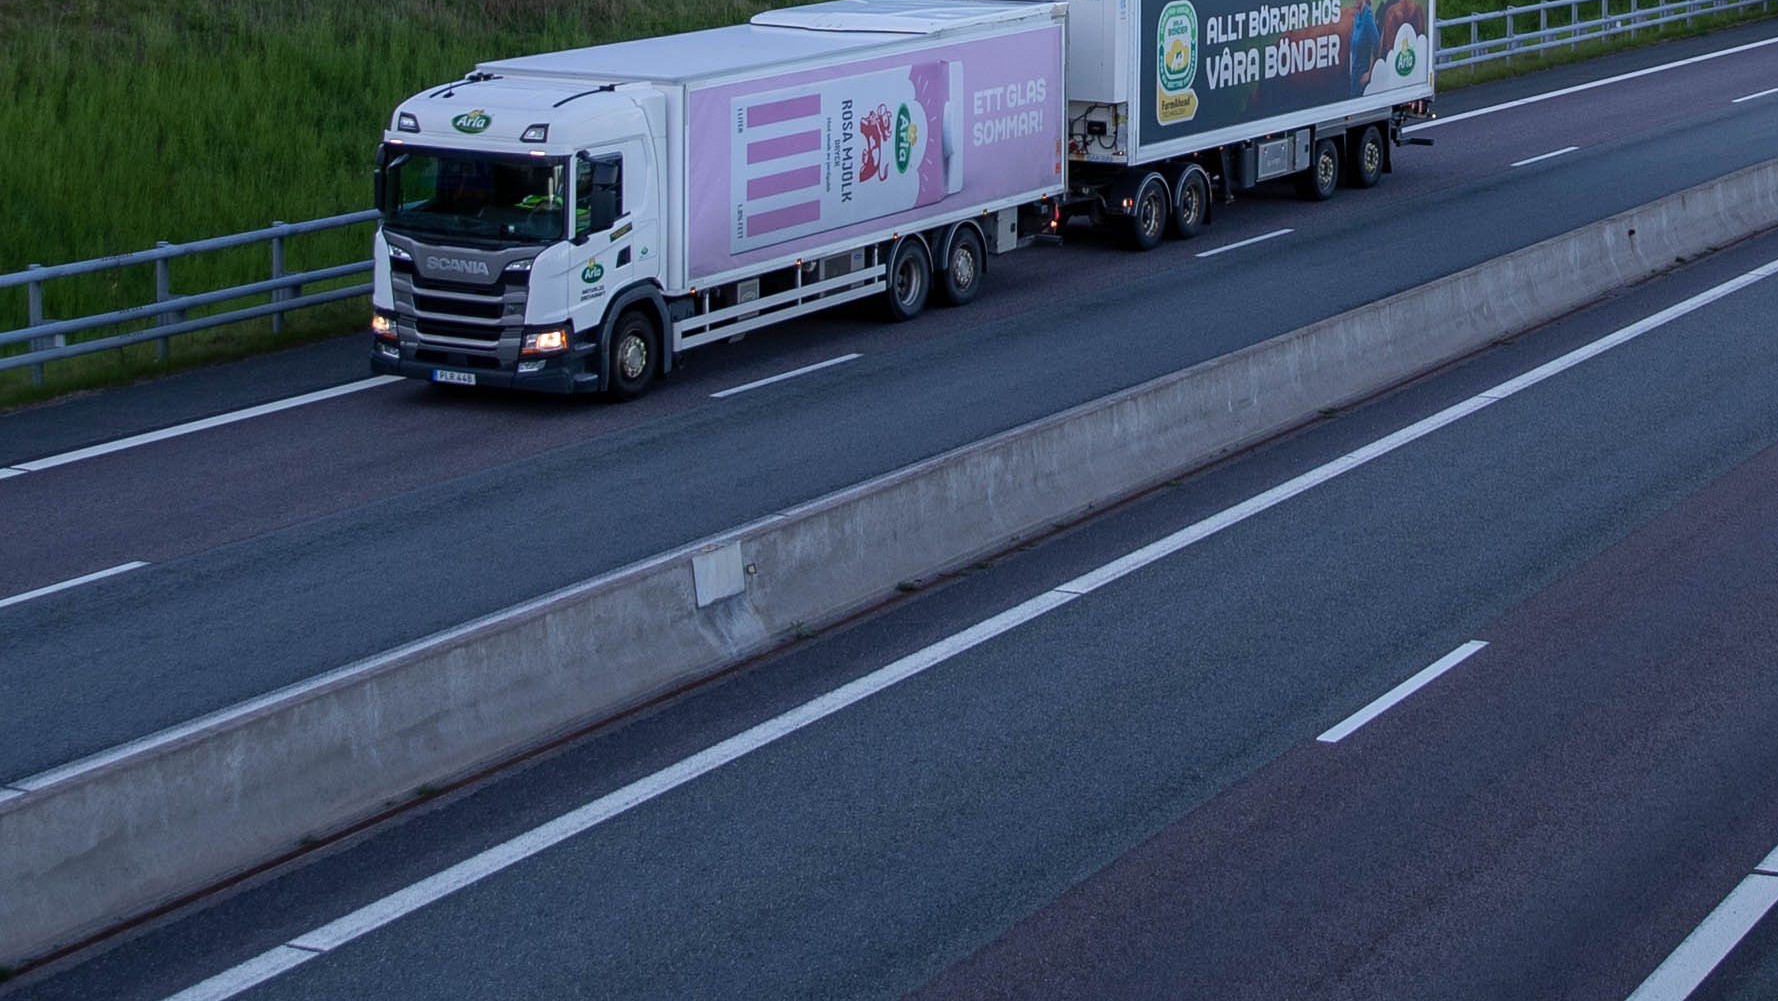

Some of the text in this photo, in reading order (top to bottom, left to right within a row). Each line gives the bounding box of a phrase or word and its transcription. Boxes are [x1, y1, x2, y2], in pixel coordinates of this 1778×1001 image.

[1206, 12, 1246, 45] ALLT
[1249, 3, 1308, 37] BÖRJAR
[1206, 47, 1260, 90] VÅRA
[1264, 33, 1341, 79] BÖNDER
[1397, 55, 1414, 70] Arla
[973, 77, 1047, 115] ETT GLAS
[456, 115, 486, 129] Arla
[841, 99, 853, 143] ROSA
[900, 115, 909, 163] Arla
[973, 110, 1044, 147] SOMMAR!
[426, 255, 489, 277] SCANIA
[584, 267, 601, 280] Arla
